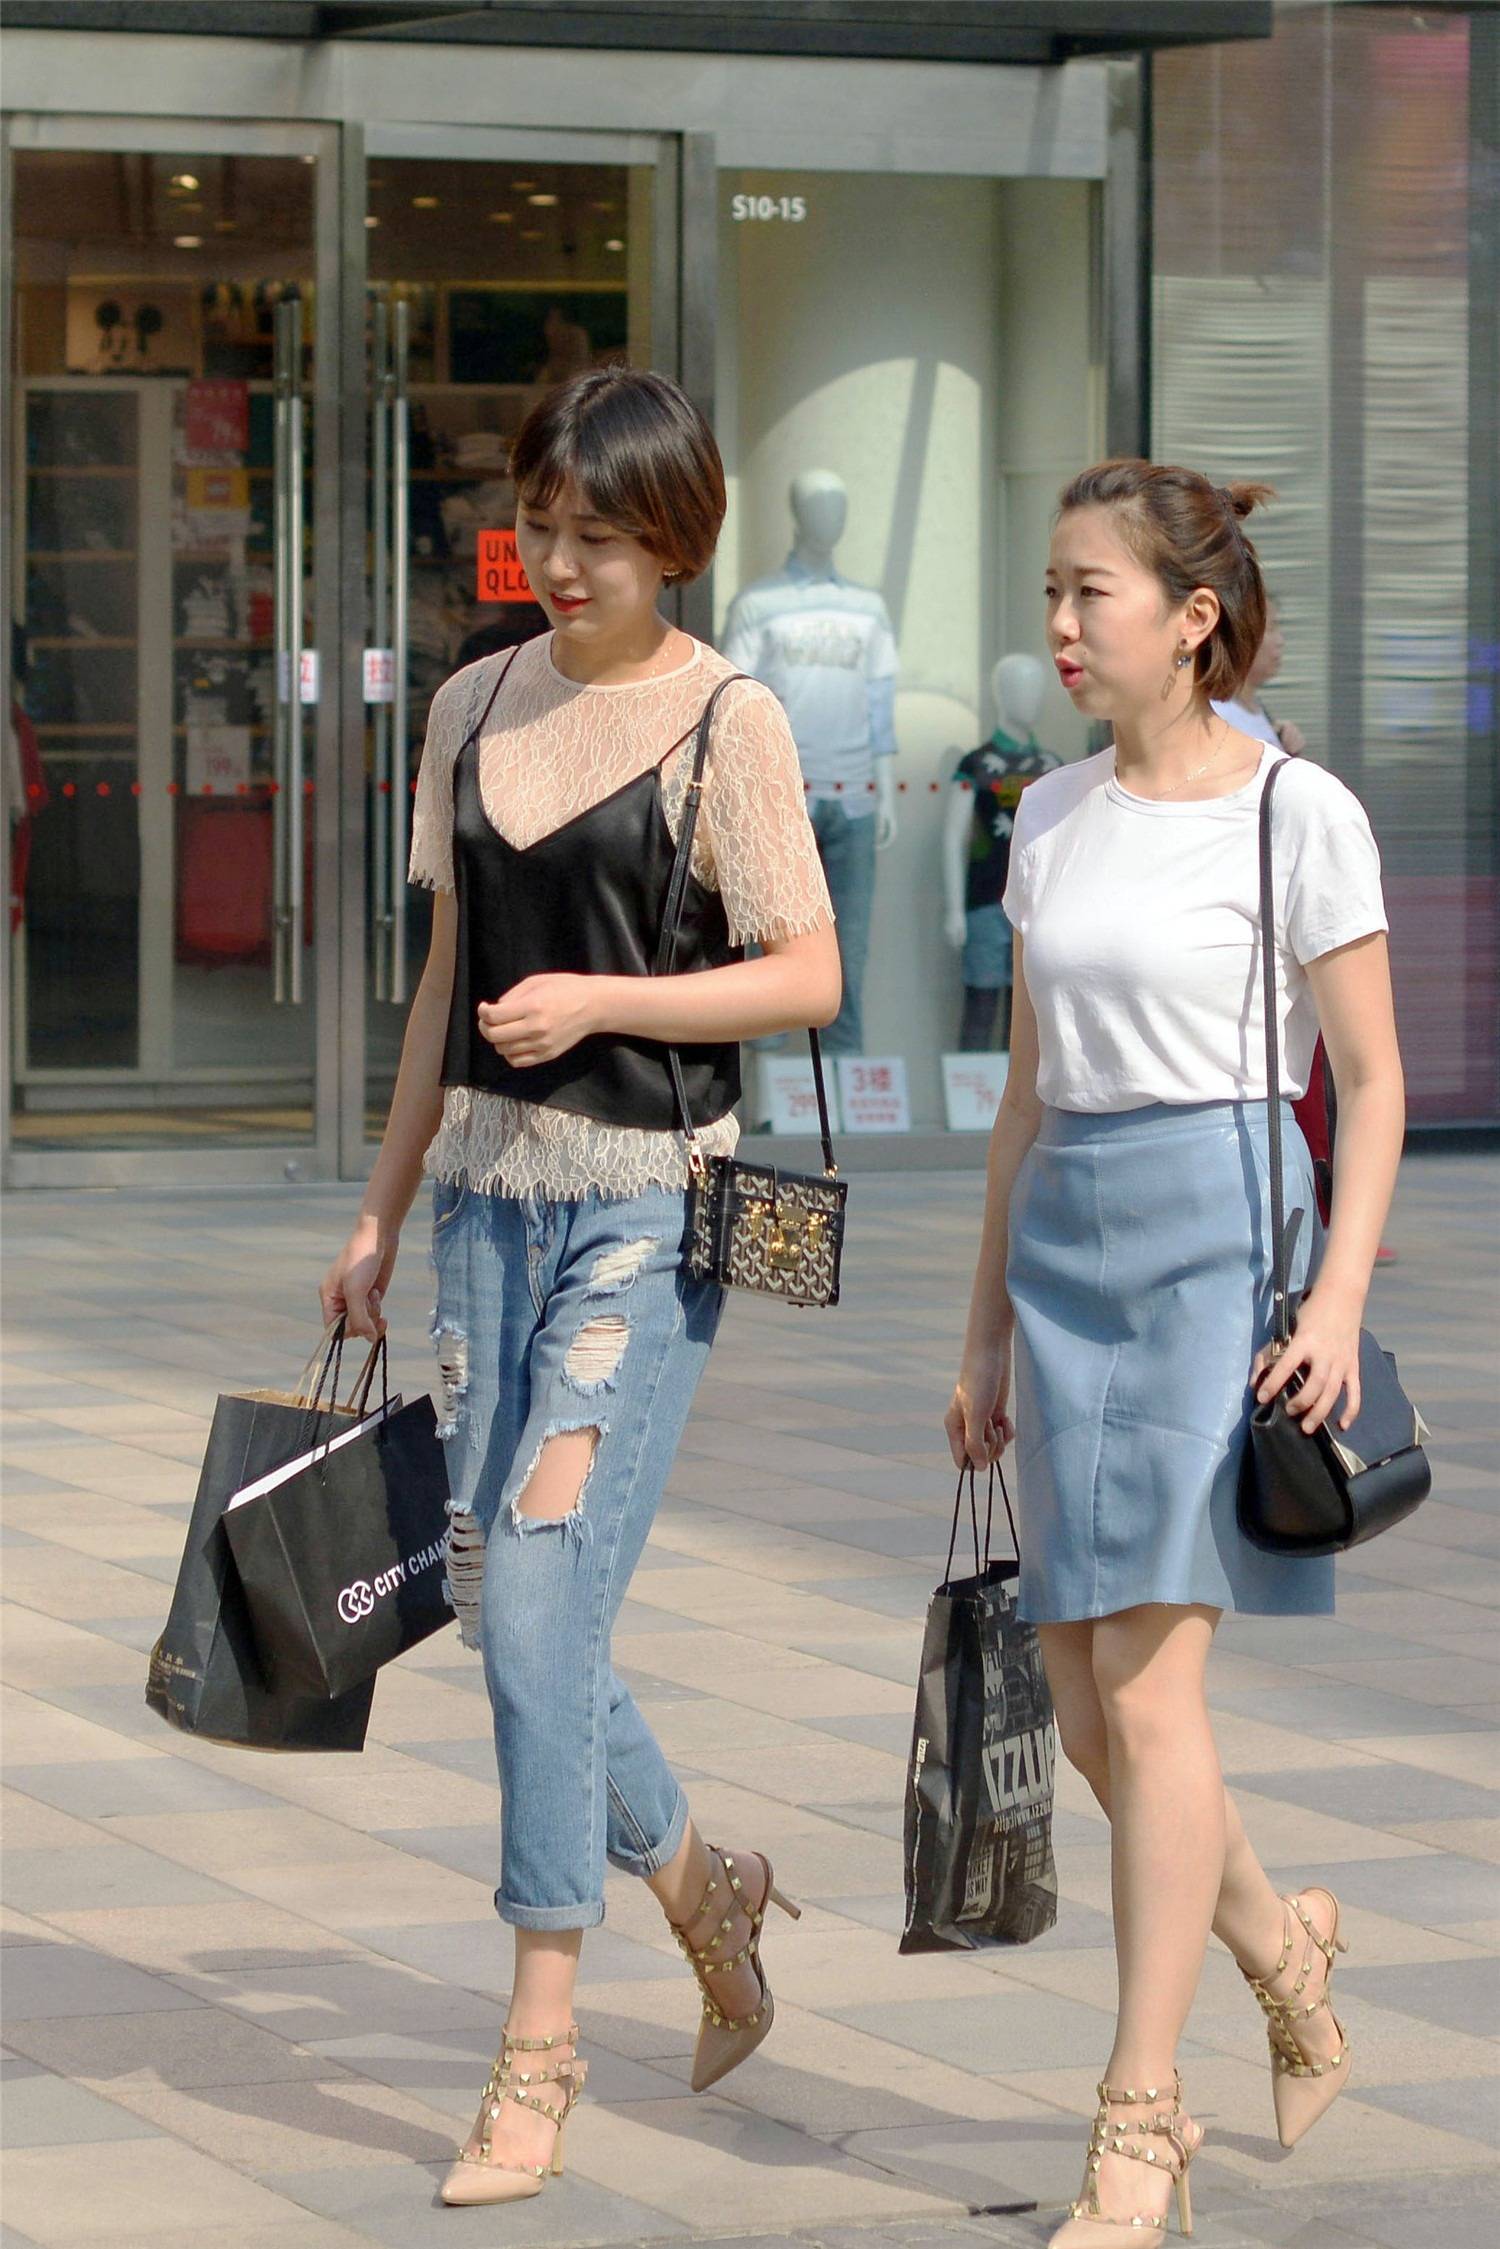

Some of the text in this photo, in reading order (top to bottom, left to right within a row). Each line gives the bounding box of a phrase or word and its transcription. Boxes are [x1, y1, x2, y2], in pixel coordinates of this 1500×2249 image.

[732, 194, 806, 222] S10-15
[486, 540, 517, 562] UN
[374, 1562, 407, 1597] CITY
